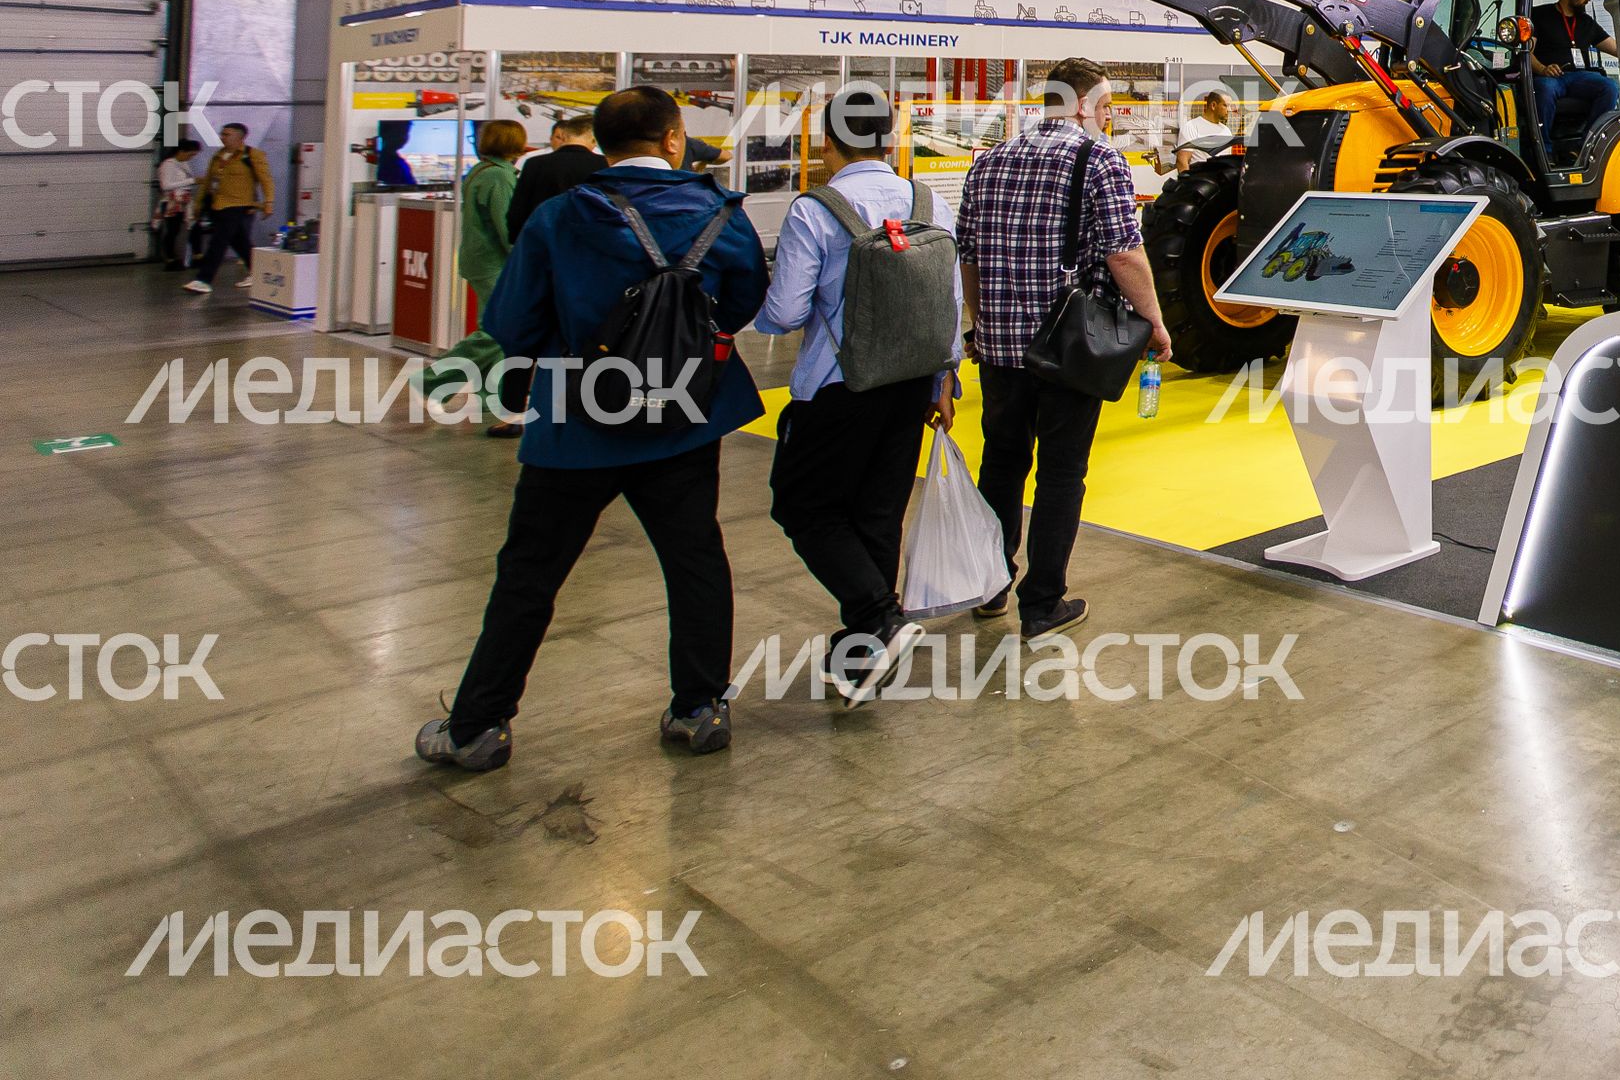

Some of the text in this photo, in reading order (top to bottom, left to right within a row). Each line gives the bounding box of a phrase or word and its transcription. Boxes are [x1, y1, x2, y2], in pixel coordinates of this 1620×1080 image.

[819, 30, 959, 47] TJK MACHINERY
[916, 107, 935, 116] TJK
[1024, 107, 1041, 116] TJK
[1116, 107, 1132, 116] TJK
[939, 159, 973, 169] КОМПА
[402, 248, 429, 280] TJK
